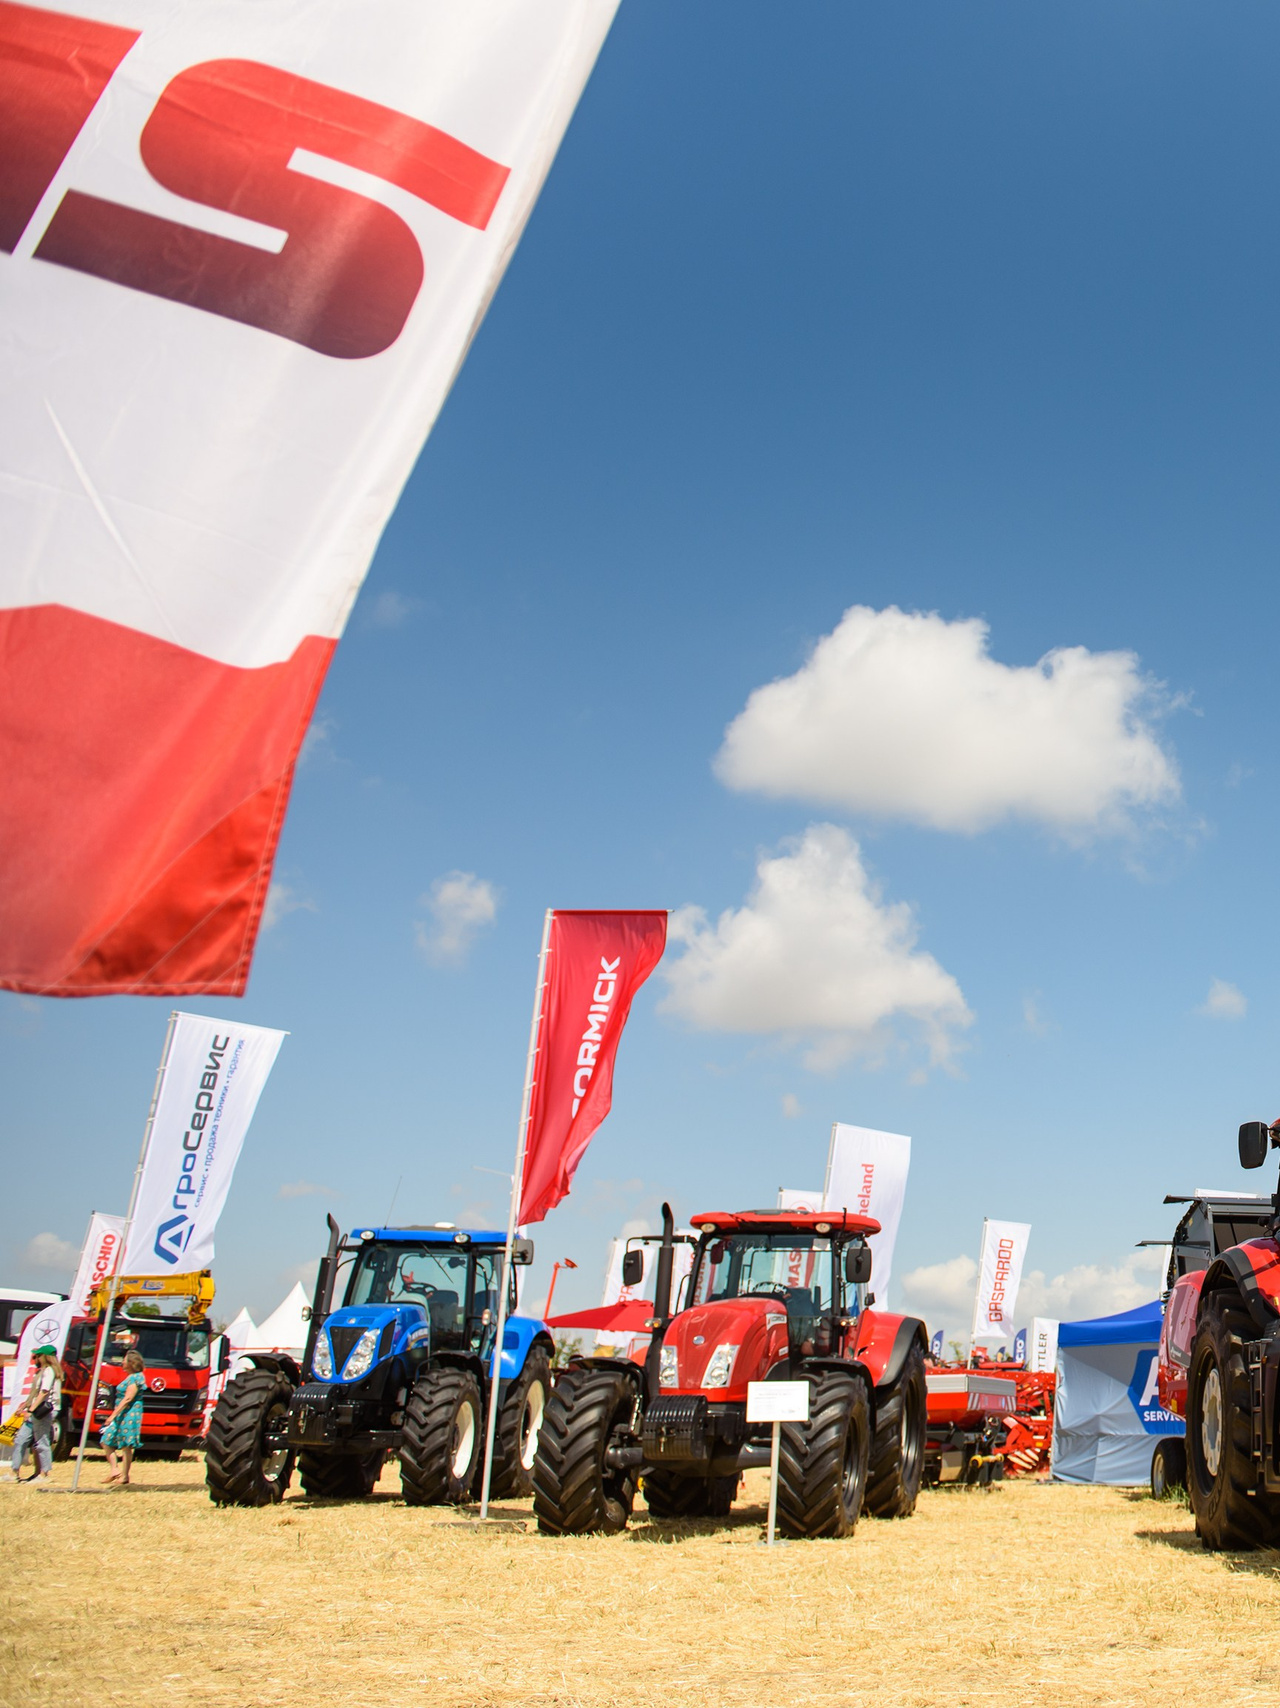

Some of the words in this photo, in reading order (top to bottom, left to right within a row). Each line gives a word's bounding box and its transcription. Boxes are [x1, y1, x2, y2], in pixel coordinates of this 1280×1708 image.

[194, 1173, 209, 1208] сервис
[204, 1123, 219, 1166] продажа
[988, 1238, 1014, 1323] GASPARDO
